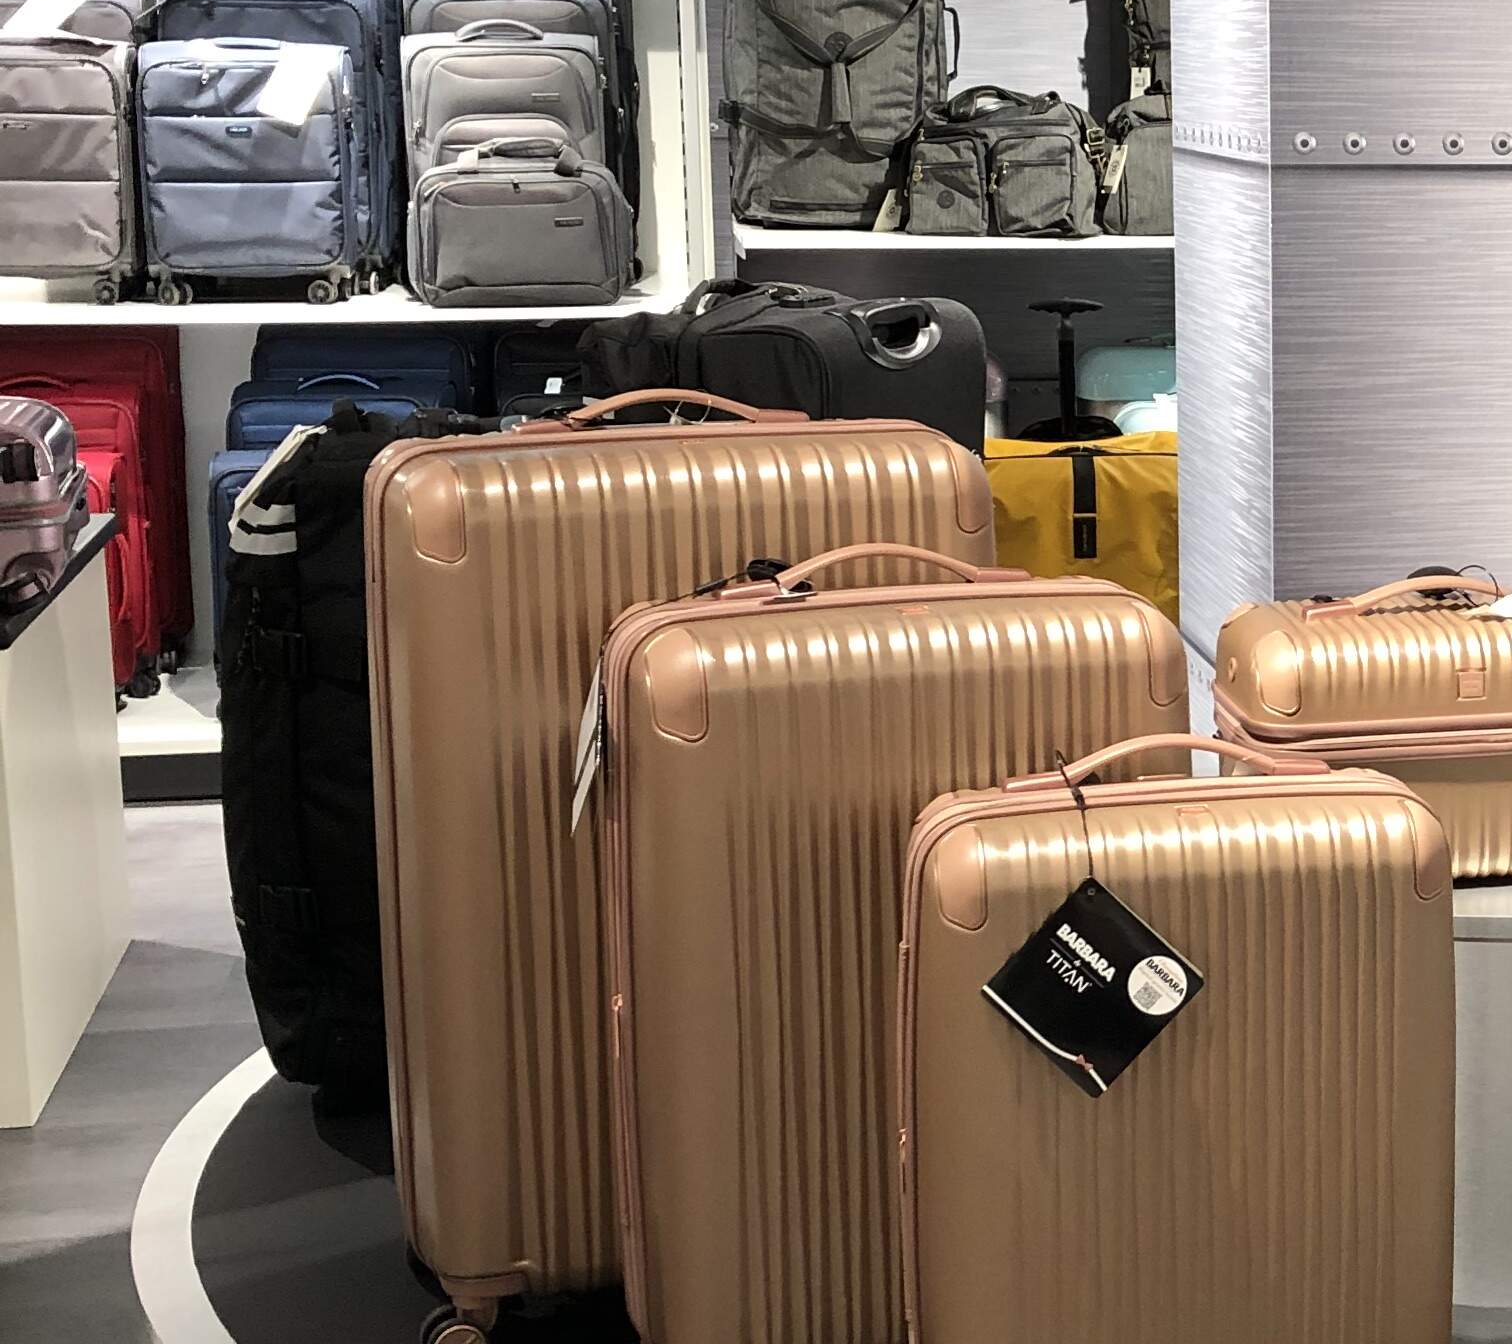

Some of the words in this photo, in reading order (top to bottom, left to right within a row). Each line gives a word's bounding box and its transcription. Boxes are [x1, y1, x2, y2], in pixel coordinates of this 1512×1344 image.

[1046, 949, 1090, 993] TITAN
[1056, 923, 1116, 982] BARBARA
[1145, 958, 1185, 997] BARBARA
